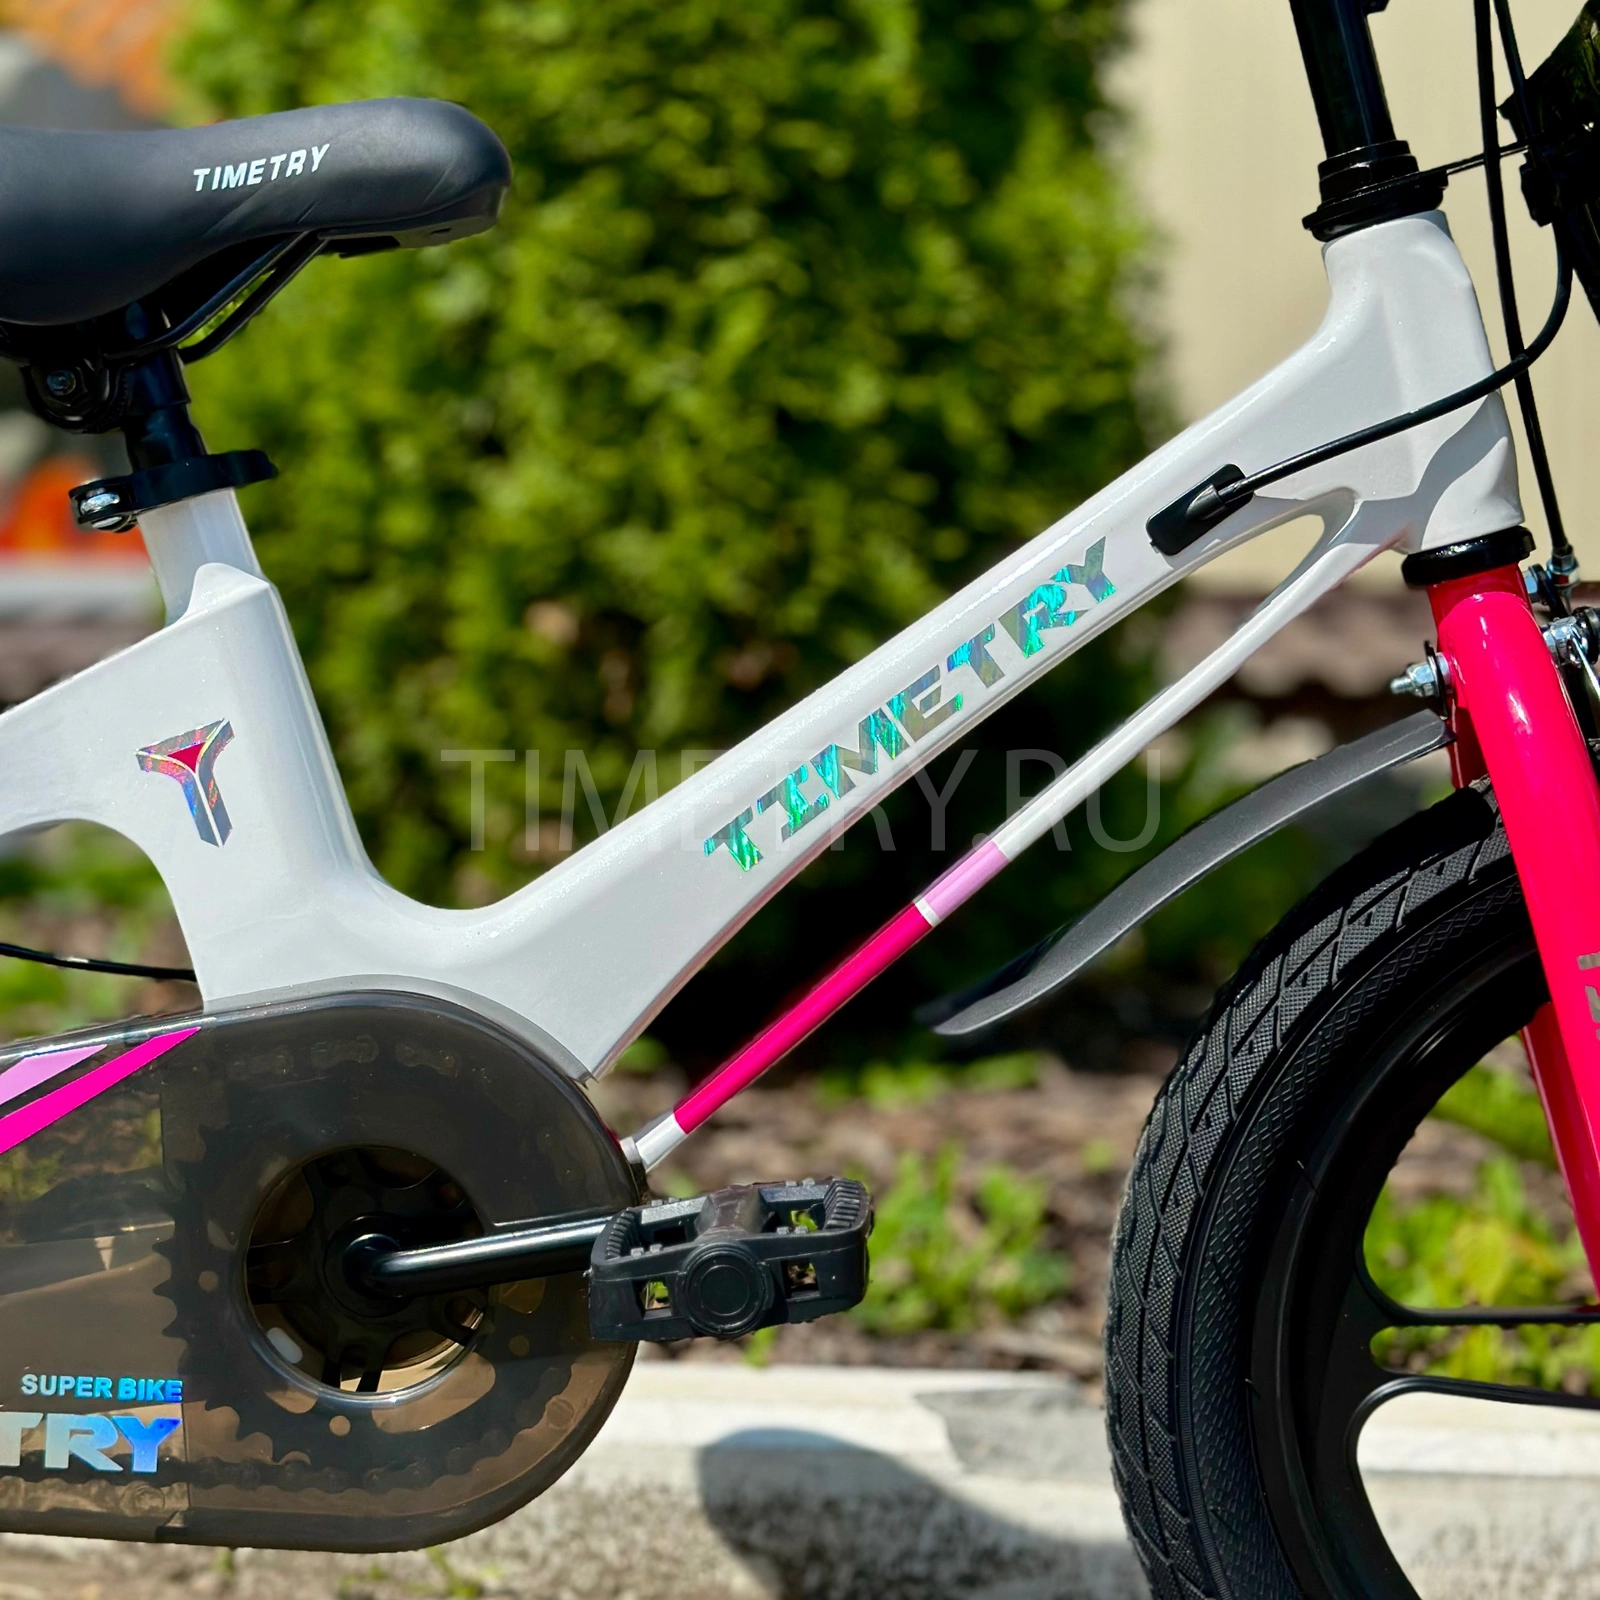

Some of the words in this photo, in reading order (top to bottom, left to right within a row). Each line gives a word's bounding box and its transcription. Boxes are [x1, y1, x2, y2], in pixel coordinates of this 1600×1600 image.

[193, 143, 330, 192] TIMETRY
[704, 536, 1117, 872] TIMETRY
[21, 1374, 112, 1398] SUPER
[118, 1378, 183, 1402] BIKE
